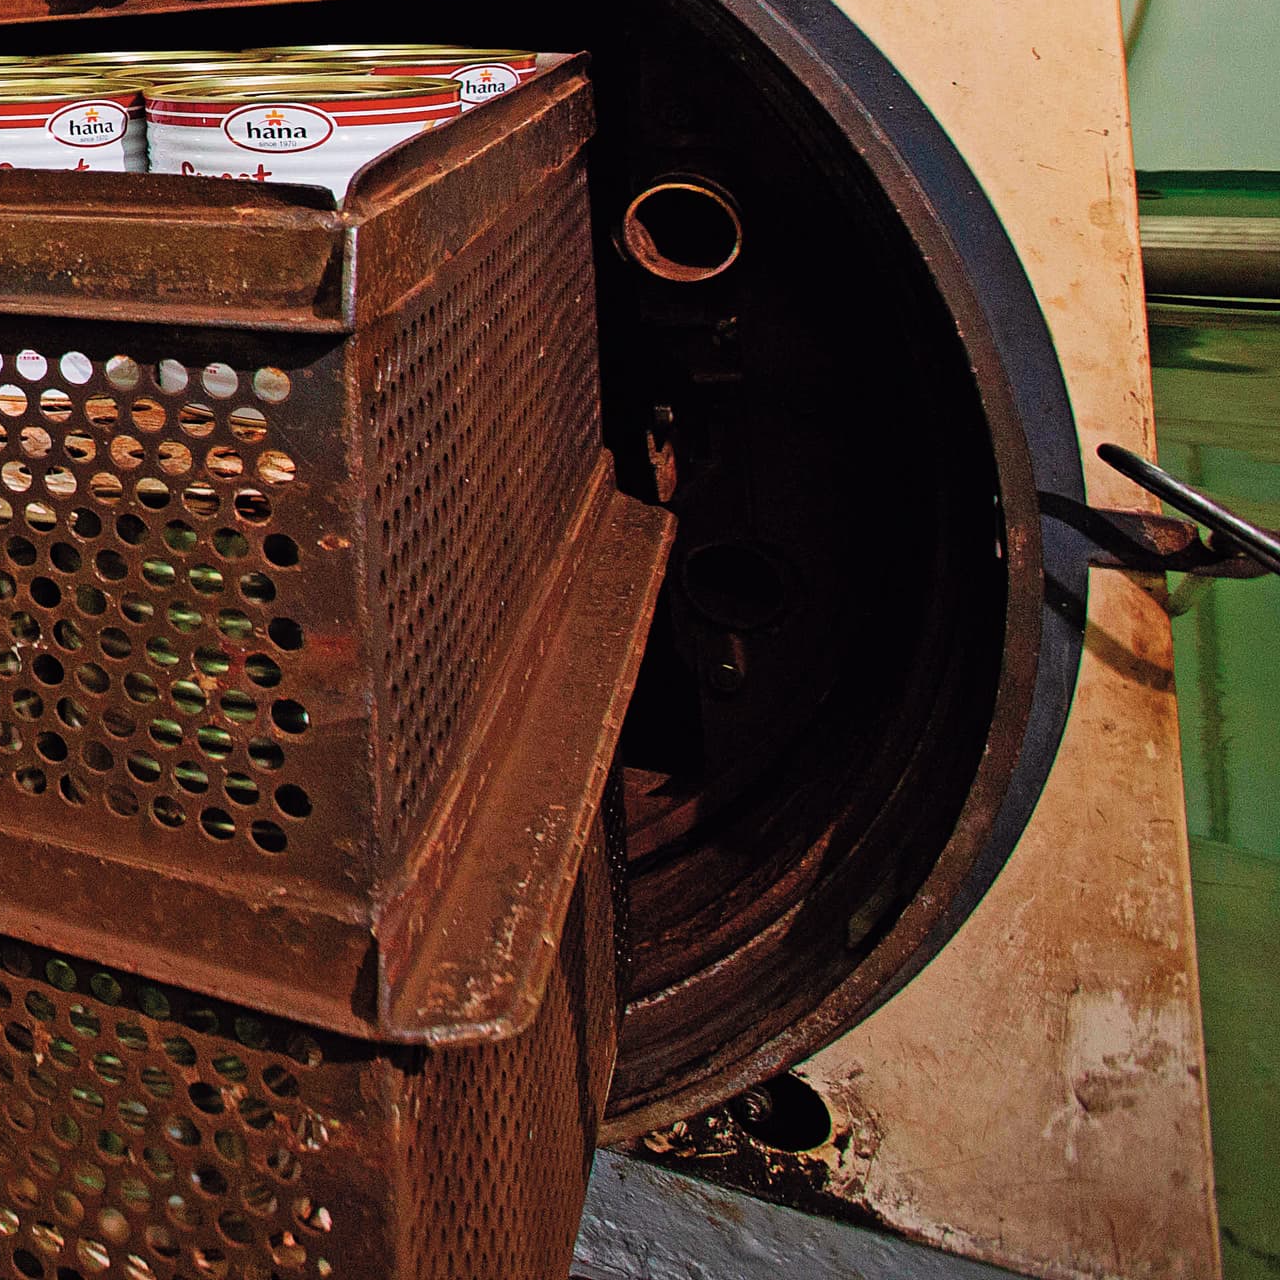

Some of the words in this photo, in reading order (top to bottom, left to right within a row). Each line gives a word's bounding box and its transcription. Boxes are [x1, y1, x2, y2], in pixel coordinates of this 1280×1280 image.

[466, 80, 506, 94] hana
[69, 119, 115, 136] hana
[246, 121, 307, 139] hana
